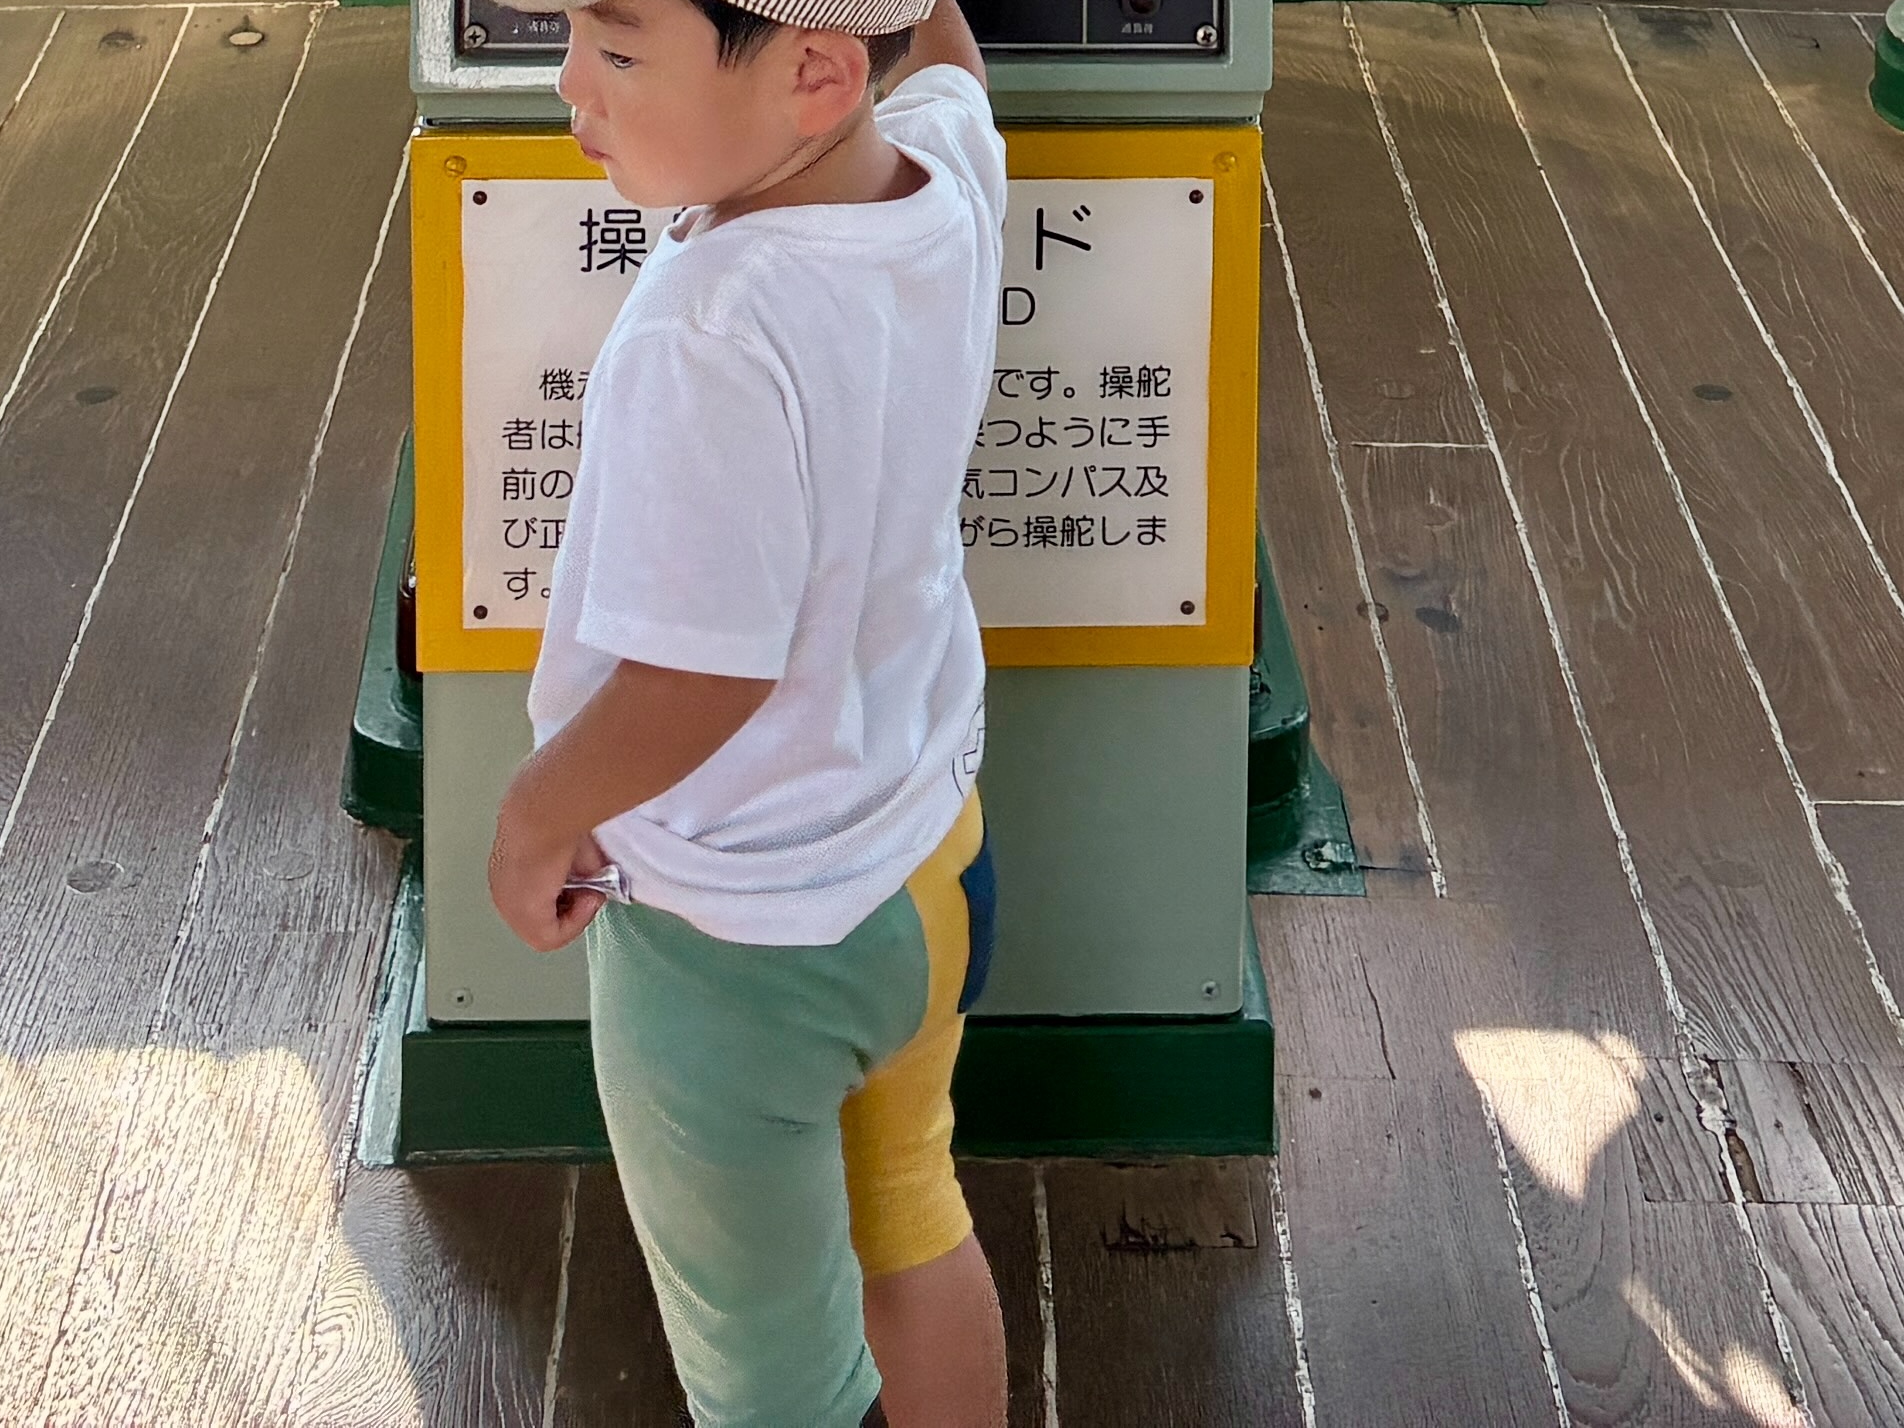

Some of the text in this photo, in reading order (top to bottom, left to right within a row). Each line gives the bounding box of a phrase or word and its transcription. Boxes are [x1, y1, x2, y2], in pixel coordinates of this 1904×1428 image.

[993, 365, 1171, 401] です。操舵
[501, 417, 583, 452] 者は
[503, 567, 551, 602] す。
